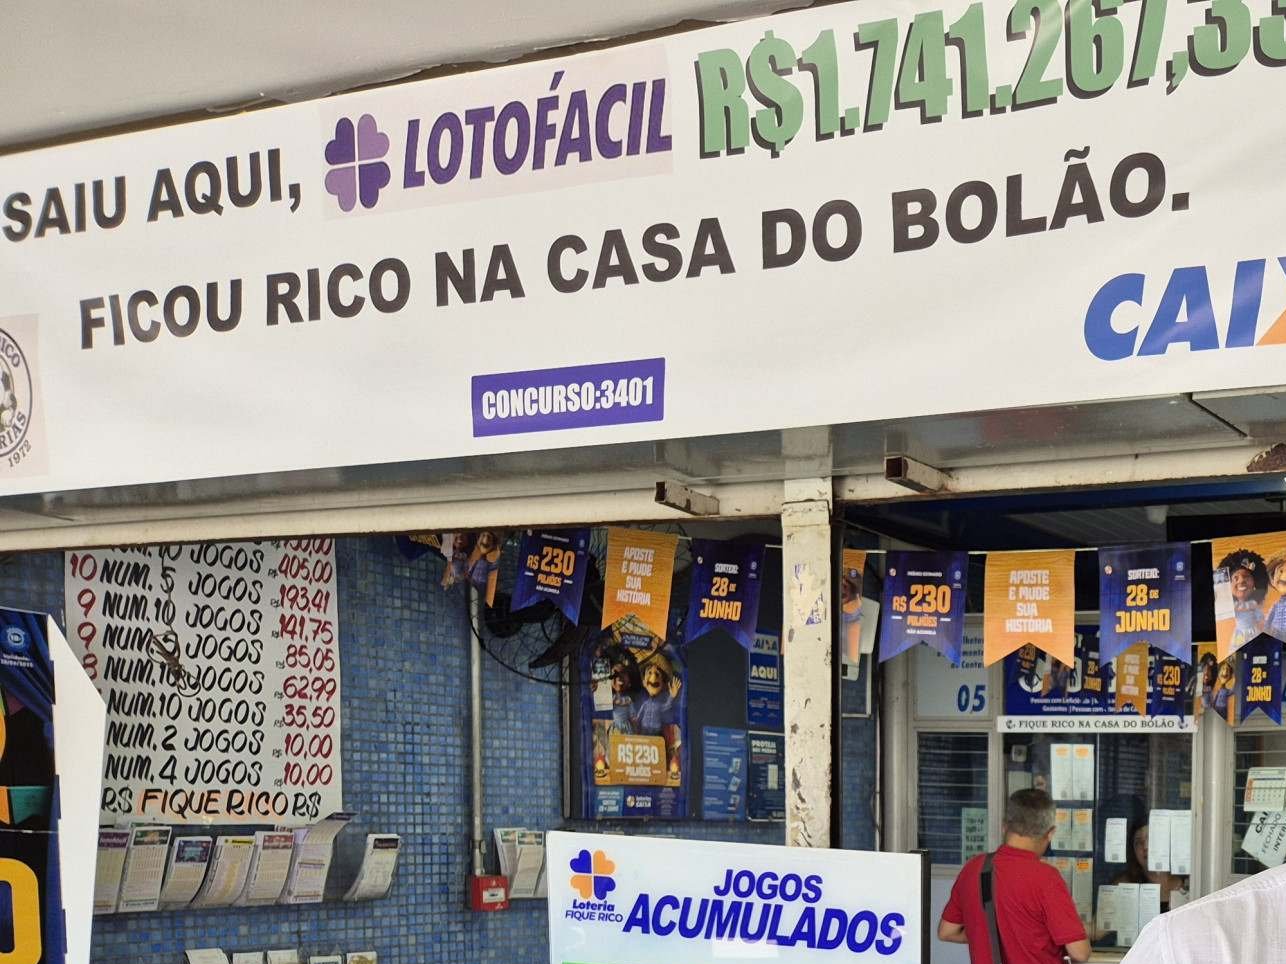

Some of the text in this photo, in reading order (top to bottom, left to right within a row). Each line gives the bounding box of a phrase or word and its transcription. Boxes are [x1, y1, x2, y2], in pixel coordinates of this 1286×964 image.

[2, 176, 127, 242] SAIU
[147, 148, 302, 215] AQUI,
[403, 71, 672, 189] LOTOFÁCIL
[80, 146, 1191, 349] FICOU RICO NA CASA DO BOLÃO.
[482, 376, 655, 420] CONCURSO:3401
[8, 440, 32, 468] 1972
[540, 547, 575, 576] 230
[624, 547, 654, 562] APOSTE
[70, 553, 331, 613] 10 NUM. 5 JOGOS 193,41
[278, 553, 333, 585] 405,00
[1009, 570, 1049, 585] APOSTE
[711, 577, 728, 597] 28
[909, 585, 951, 613] 230
[1019, 586, 1050, 600] MUDE
[1126, 584, 1148, 607] 28
[77, 588, 334, 645] 9 NUM. 10 JOGOS 141,75
[700, 598, 742, 622] JUNHO
[1006, 615, 1053, 632] HISTÓRIA
[1115, 609, 1170, 633] JUNHO
[77, 622, 97, 650] 9
[186, 634, 263, 665] JOGOS
[285, 644, 335, 674] 85,05
[104, 655, 156, 687] NUM.
[186, 665, 264, 695] JOGOS
[283, 676, 337, 702] 62,99
[751, 665, 778, 680] AQUI
[1162, 665, 1181, 686] 230
[1251, 667, 1262, 683] 28
[958, 684, 987, 712] 05
[1246, 686, 1271, 702] JUNHO
[107, 688, 335, 731] NUM. 10 JOGOS 35,50
[1141, 717, 1175, 729] BOLÃO
[106, 721, 333, 759] NUM. 2 JOGOS 10,00
[636, 746, 659, 765] 230
[105, 754, 333, 788] NUM. 4 JOGOS 10,00
[101, 787, 322, 821] R$ FIQUE RICO R$
[714, 869, 823, 903] JOGOS
[565, 910, 623, 922] FIQUE RICO
[573, 899, 615, 911] Loteria
[623, 893, 905, 955] ACUMULADOS
